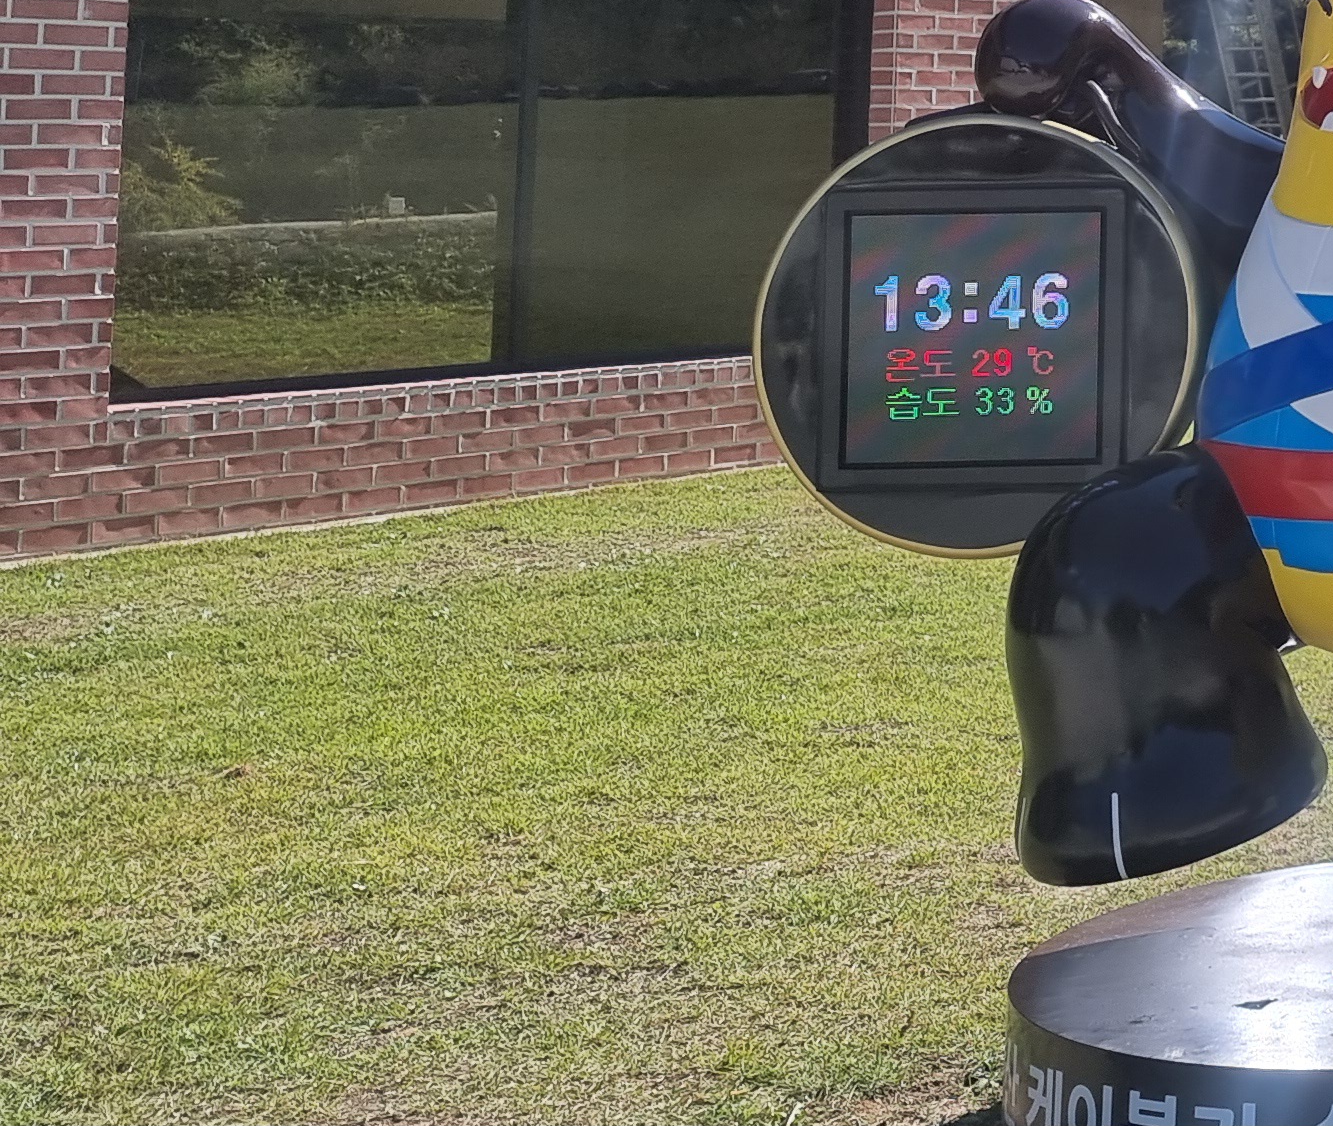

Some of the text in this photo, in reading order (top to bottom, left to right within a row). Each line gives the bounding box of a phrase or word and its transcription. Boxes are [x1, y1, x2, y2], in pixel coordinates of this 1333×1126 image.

[873, 272, 1071, 332] 13:46
[885, 347, 957, 383] 온도
[971, 347, 1013, 378] 29
[885, 385, 1054, 421] 습도 33 %
